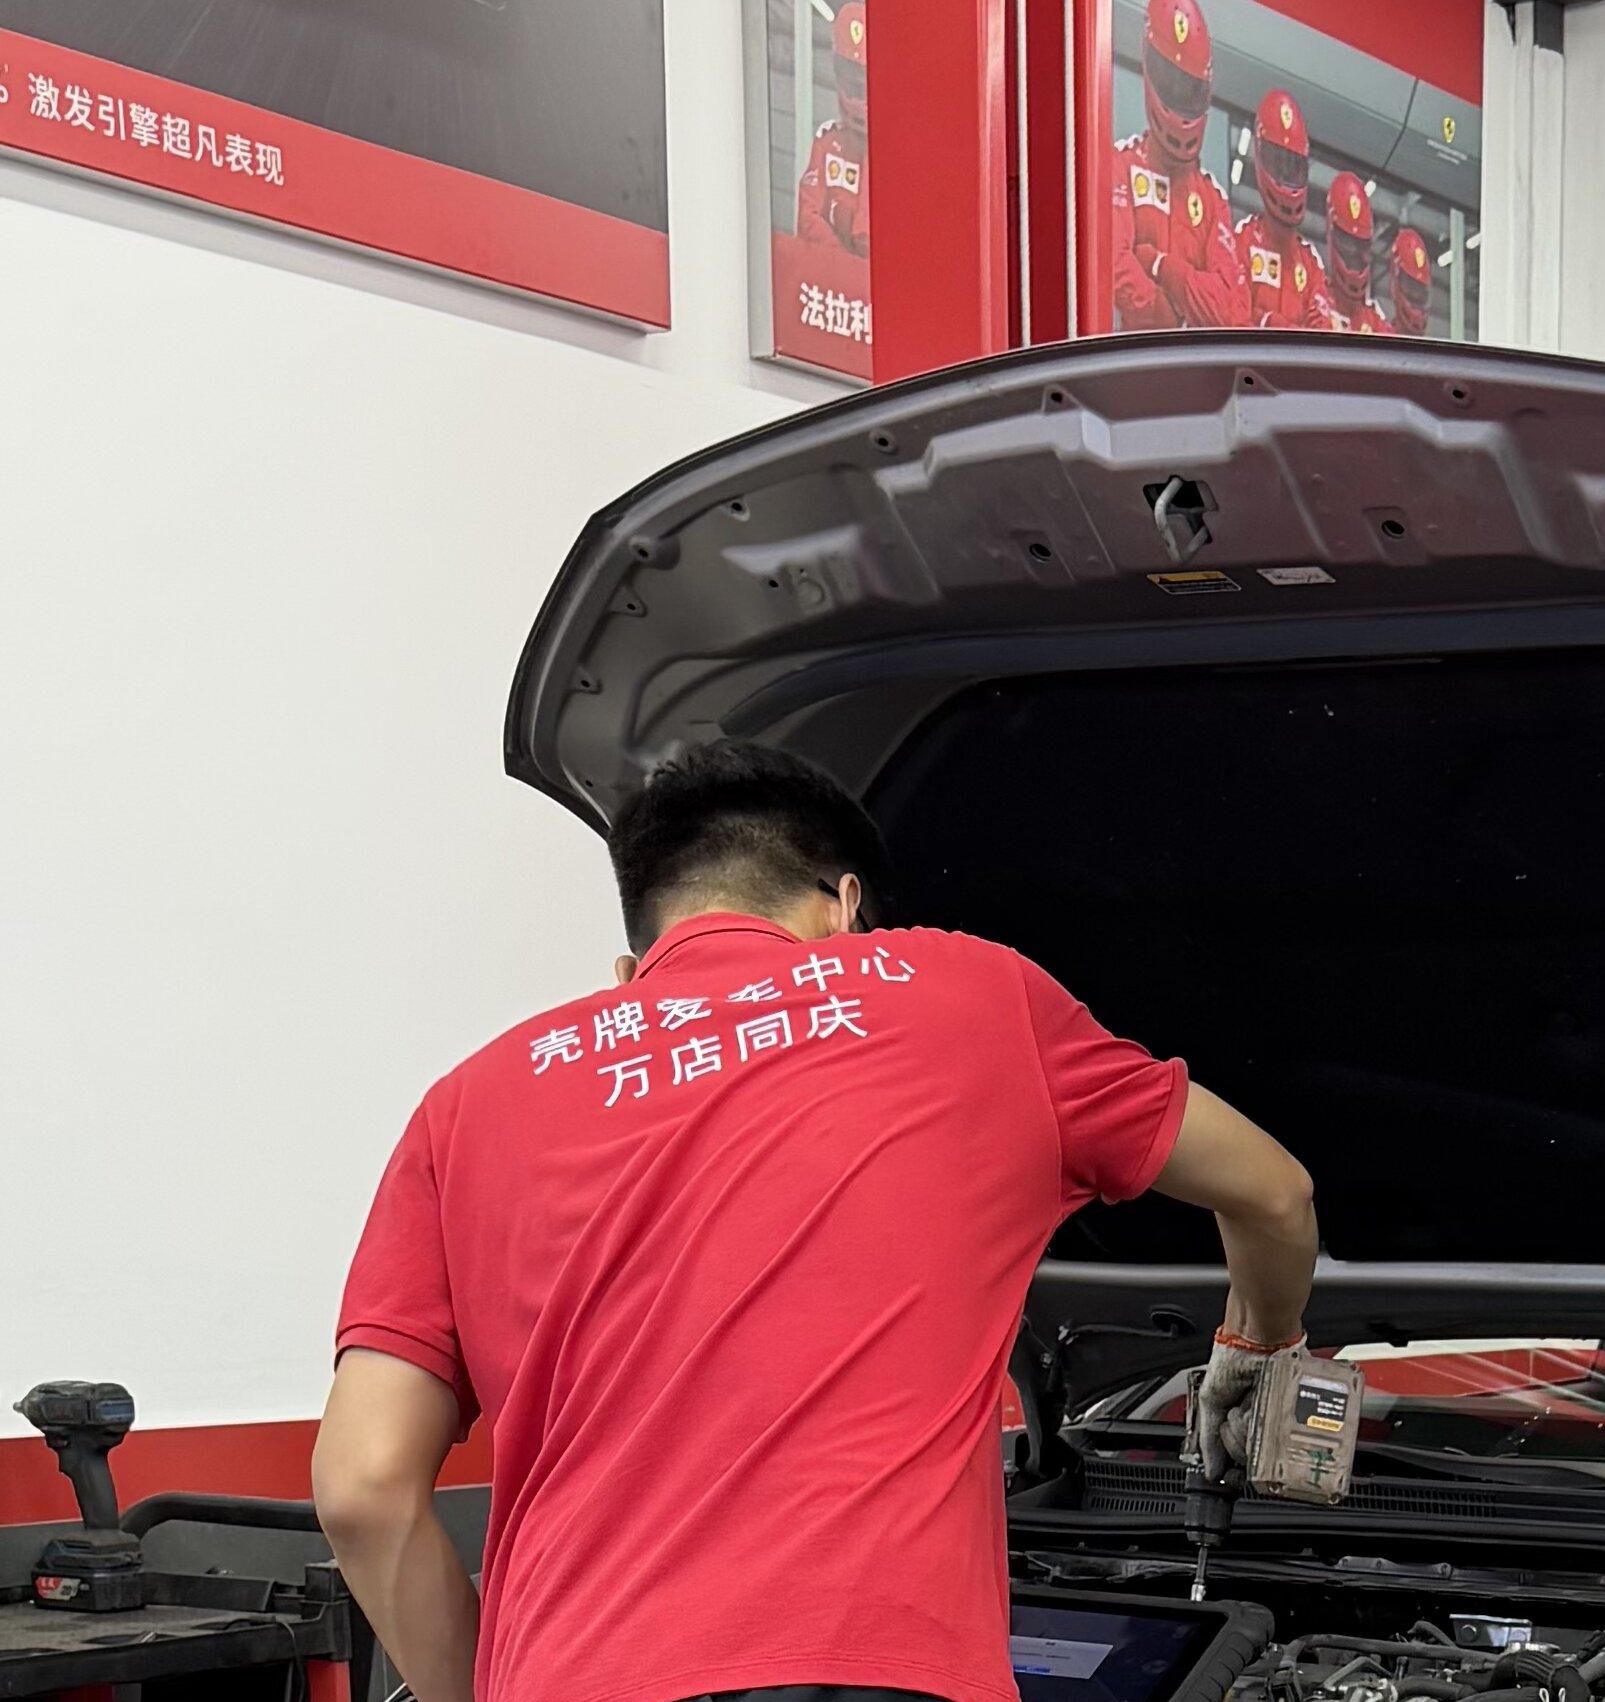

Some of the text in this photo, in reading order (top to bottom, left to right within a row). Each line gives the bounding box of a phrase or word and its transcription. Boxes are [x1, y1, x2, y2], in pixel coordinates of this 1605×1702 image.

[28, 72, 285, 186] 激发引擎超凡表现
[799, 282, 872, 345] 法拉利
[597, 994, 868, 1108] 万店同庆
